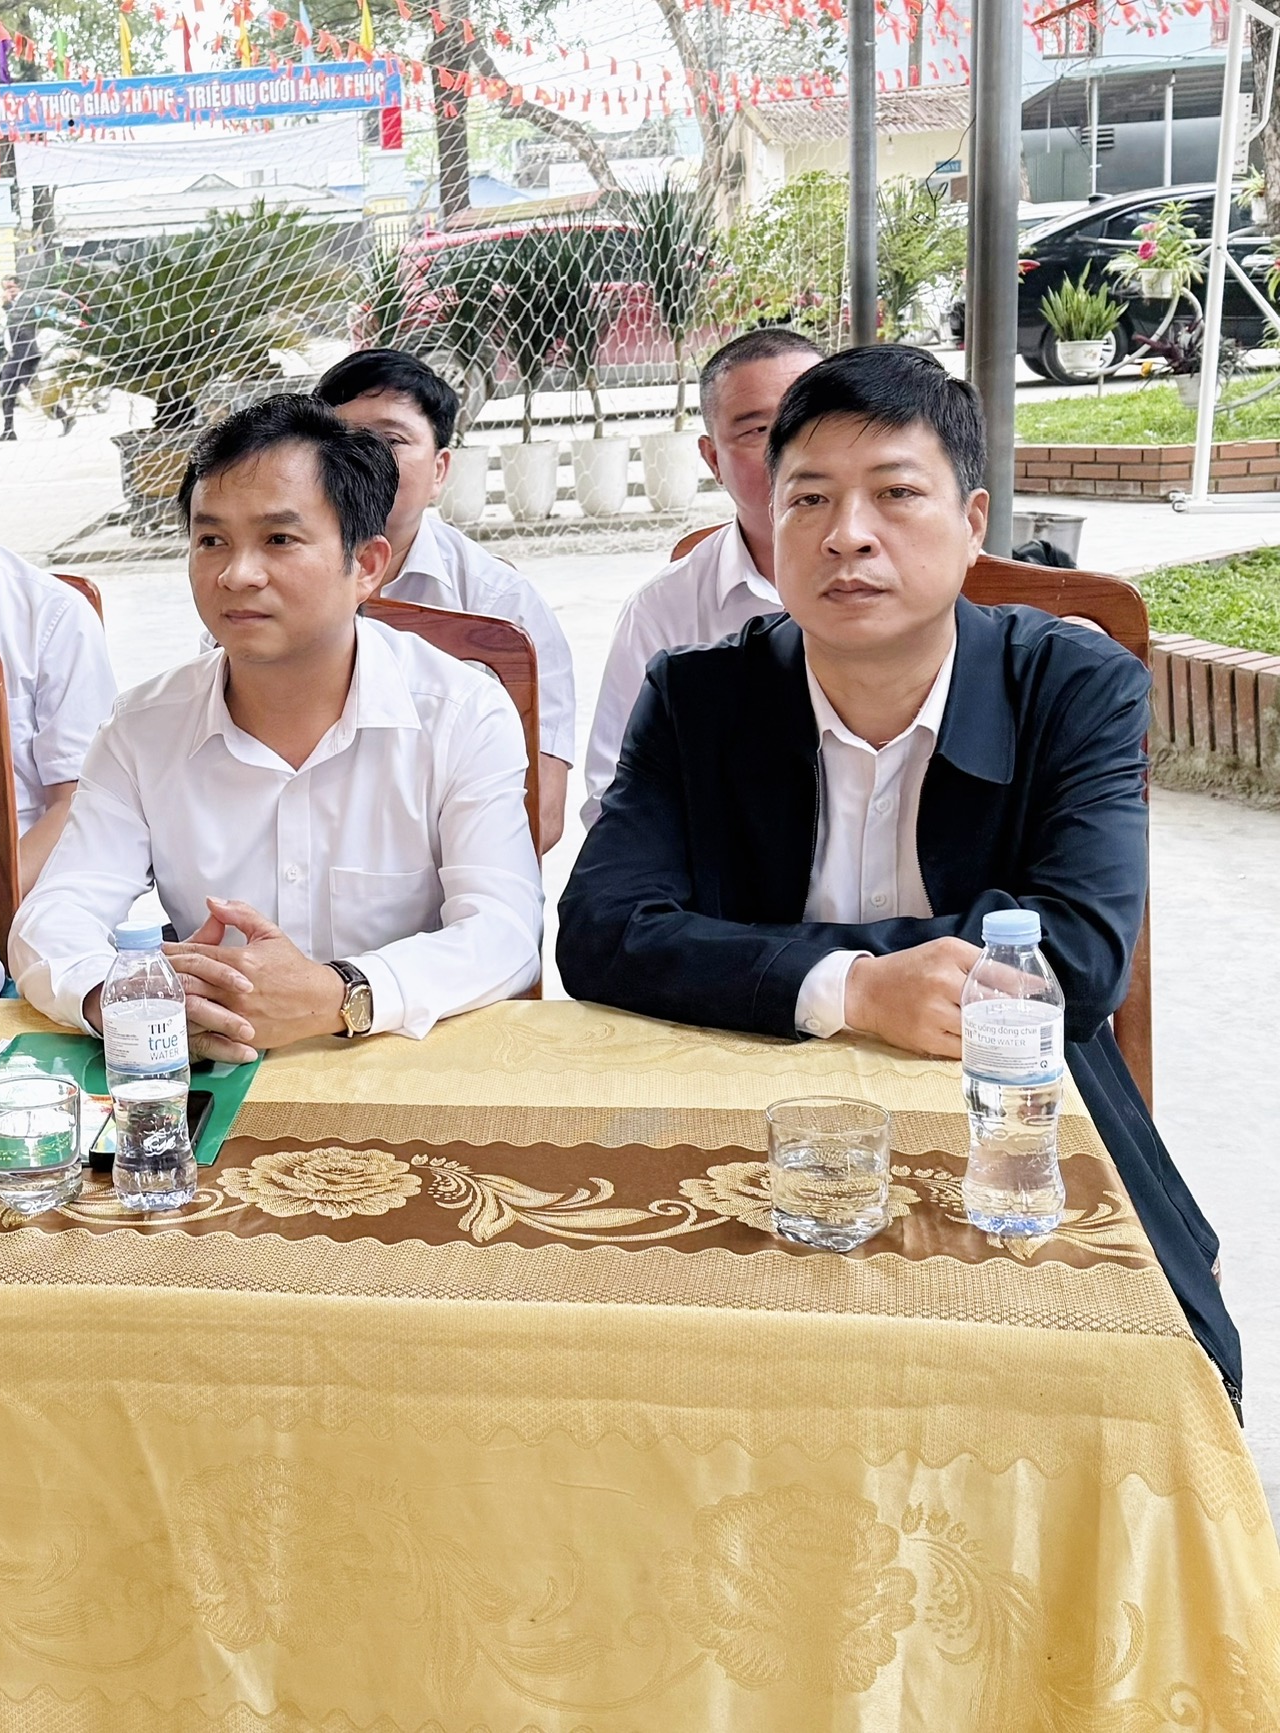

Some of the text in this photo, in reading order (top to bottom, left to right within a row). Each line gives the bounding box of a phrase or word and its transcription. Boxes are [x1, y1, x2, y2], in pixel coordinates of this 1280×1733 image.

[40, 89, 81, 119] THỨC
[83, 91, 121, 116] GIAO
[187, 81, 231, 112] TRIỆU
[234, 82, 256, 110] NỤ
[148, 1034, 178, 1051] true
[978, 1033, 996, 1045] true
[150, 1048, 179, 1060] WATER
